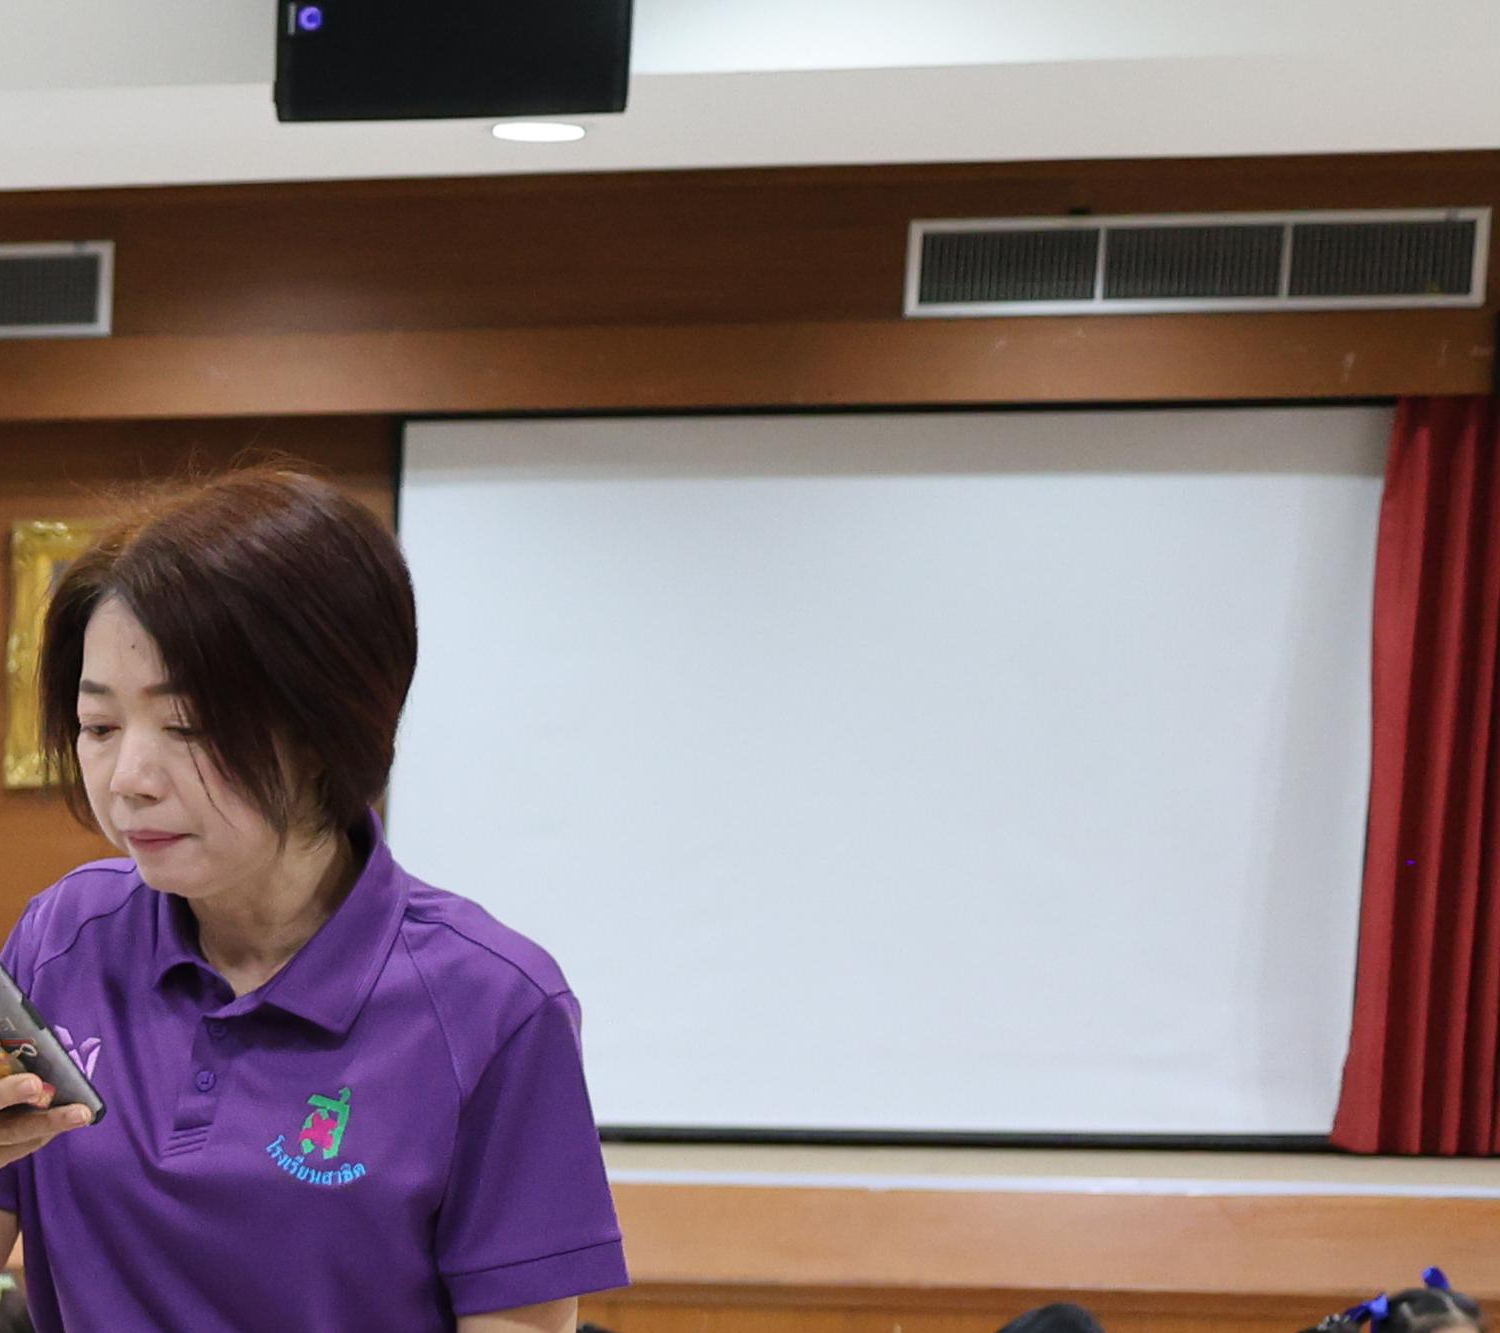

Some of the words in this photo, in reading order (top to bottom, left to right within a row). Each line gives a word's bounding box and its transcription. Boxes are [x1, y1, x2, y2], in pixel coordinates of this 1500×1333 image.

[265, 1134, 367, 1186] โรงเรียนสาธิต
